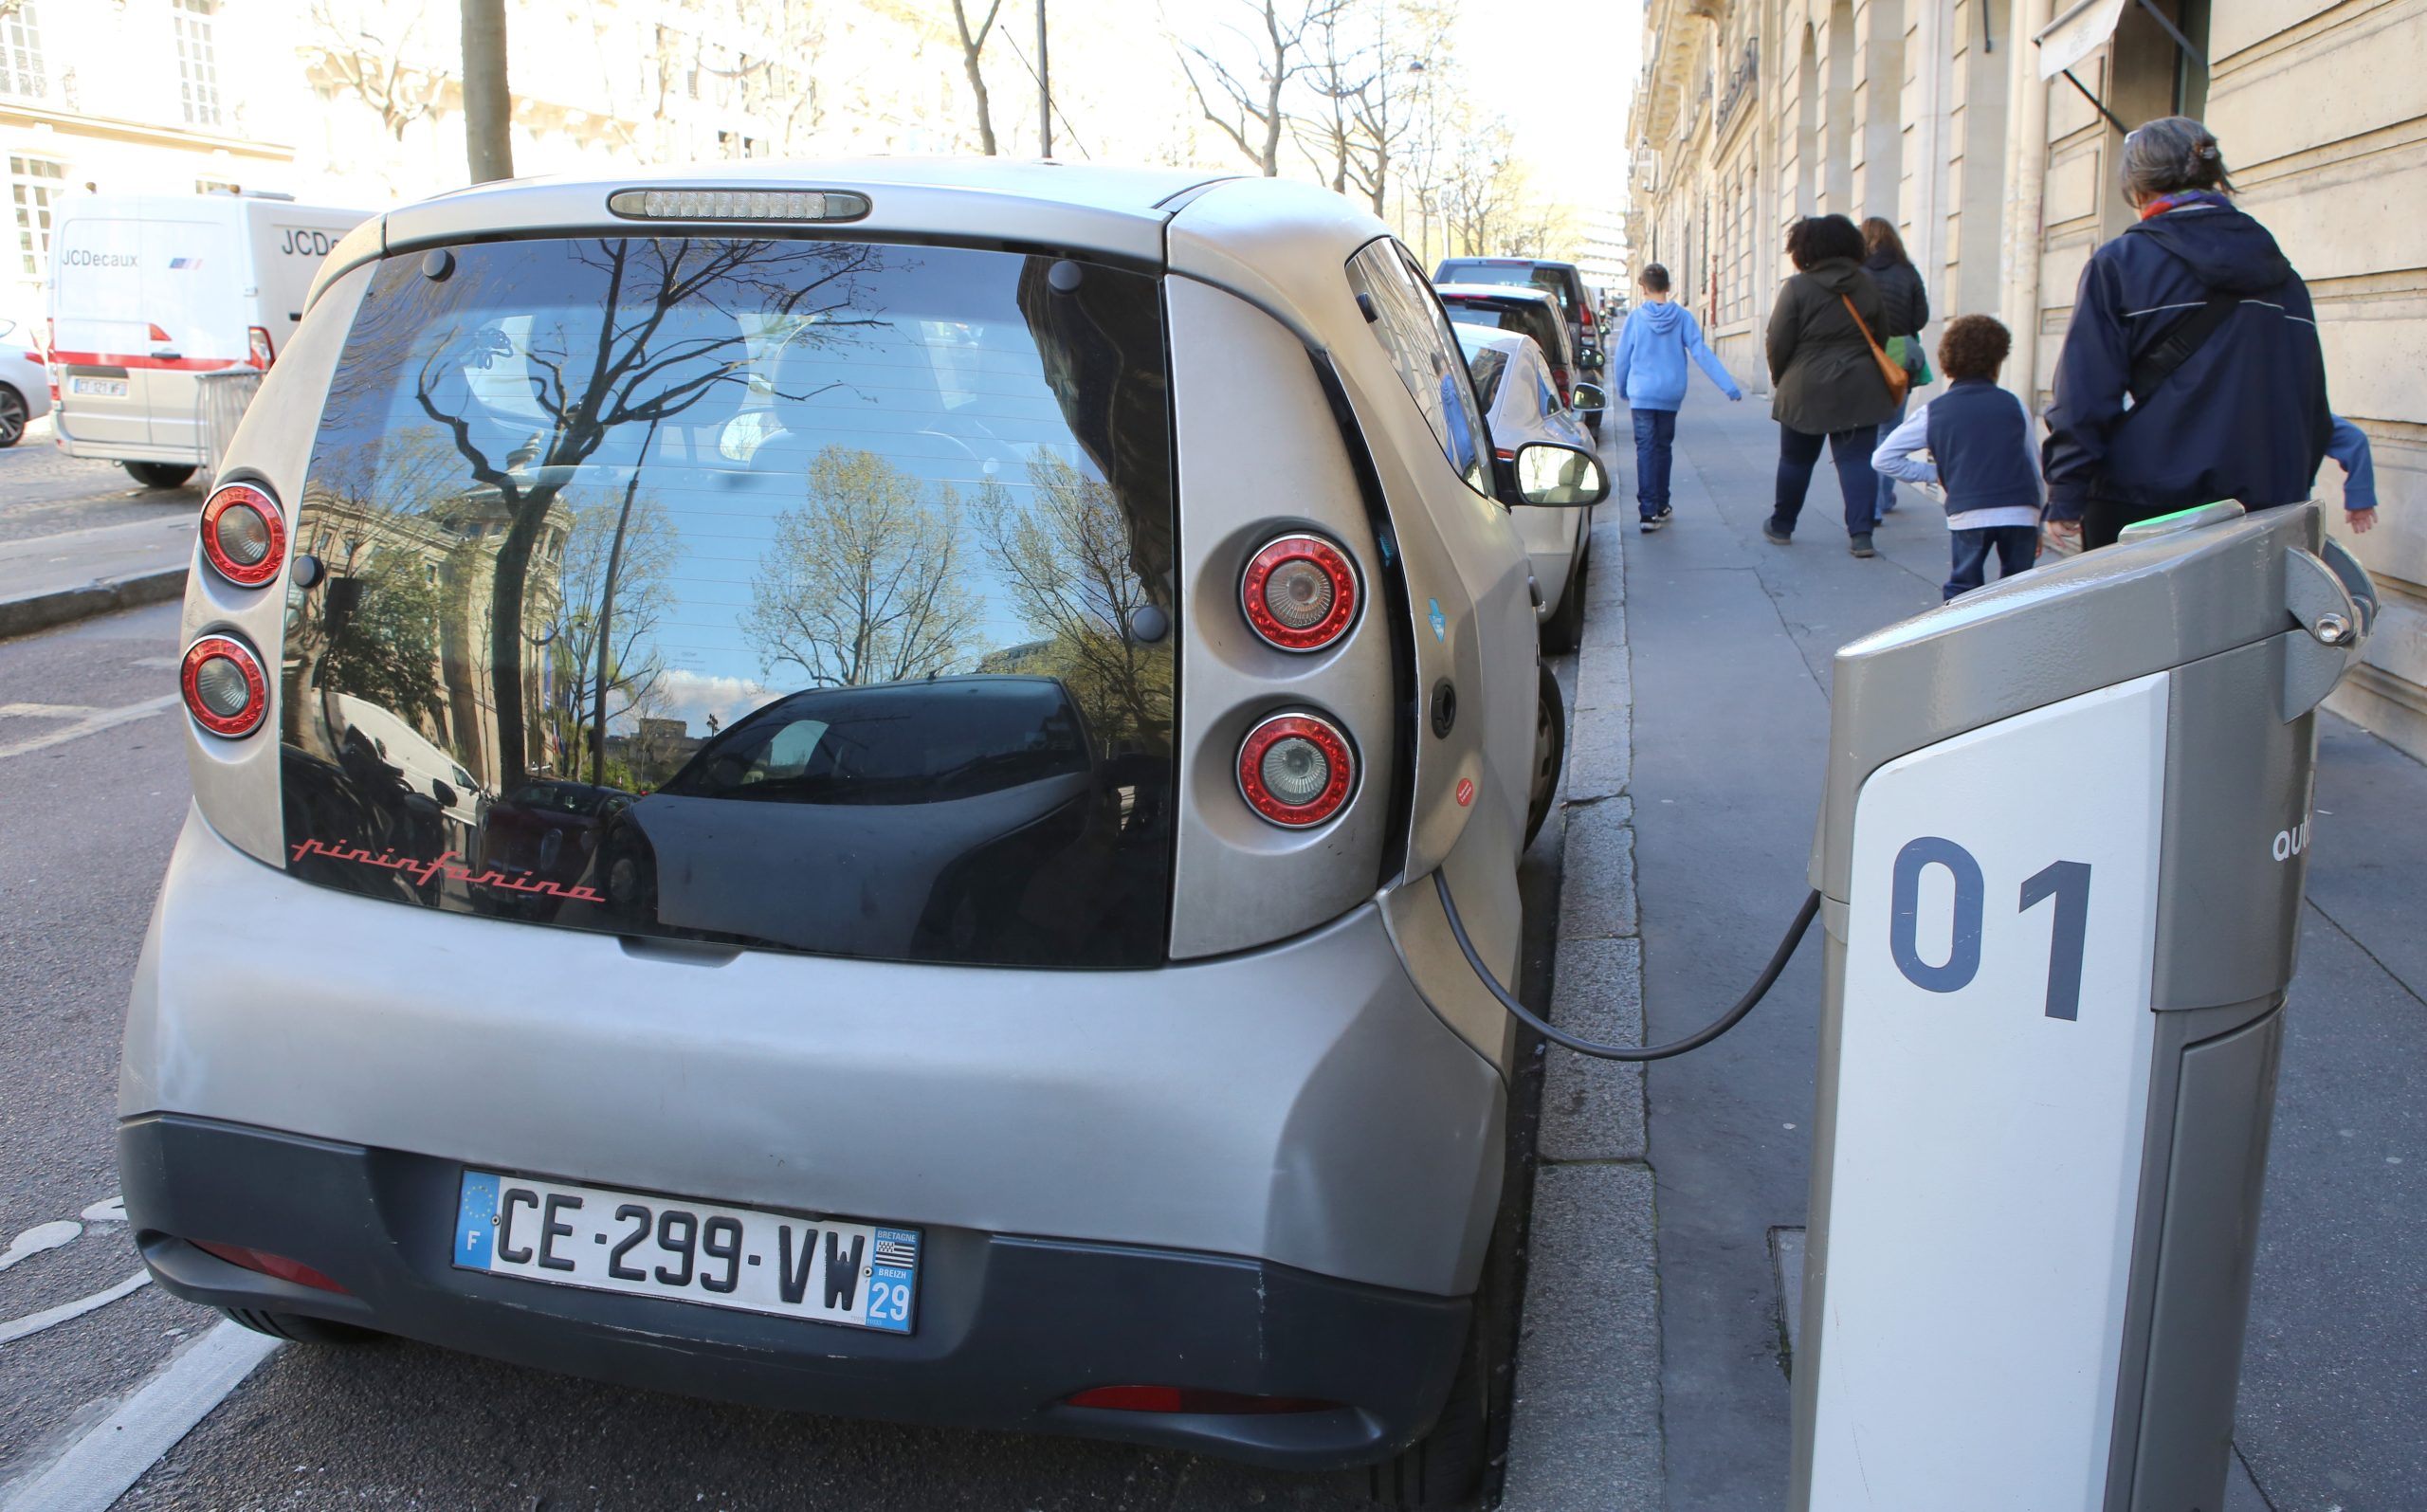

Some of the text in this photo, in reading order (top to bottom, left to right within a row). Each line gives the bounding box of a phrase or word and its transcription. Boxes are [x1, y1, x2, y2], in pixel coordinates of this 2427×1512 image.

[63, 249, 137, 266] JCDecaux
[291, 838, 606, 902] pininfarina
[1889, 835, 2092, 1022] 01
[466, 1230, 482, 1251] F
[498, 1188, 866, 1312] CE-299-VW
[877, 1230, 917, 1243] BRETAGNE
[878, 1267, 907, 1280] BREIZH
[869, 1282, 911, 1321] 29
